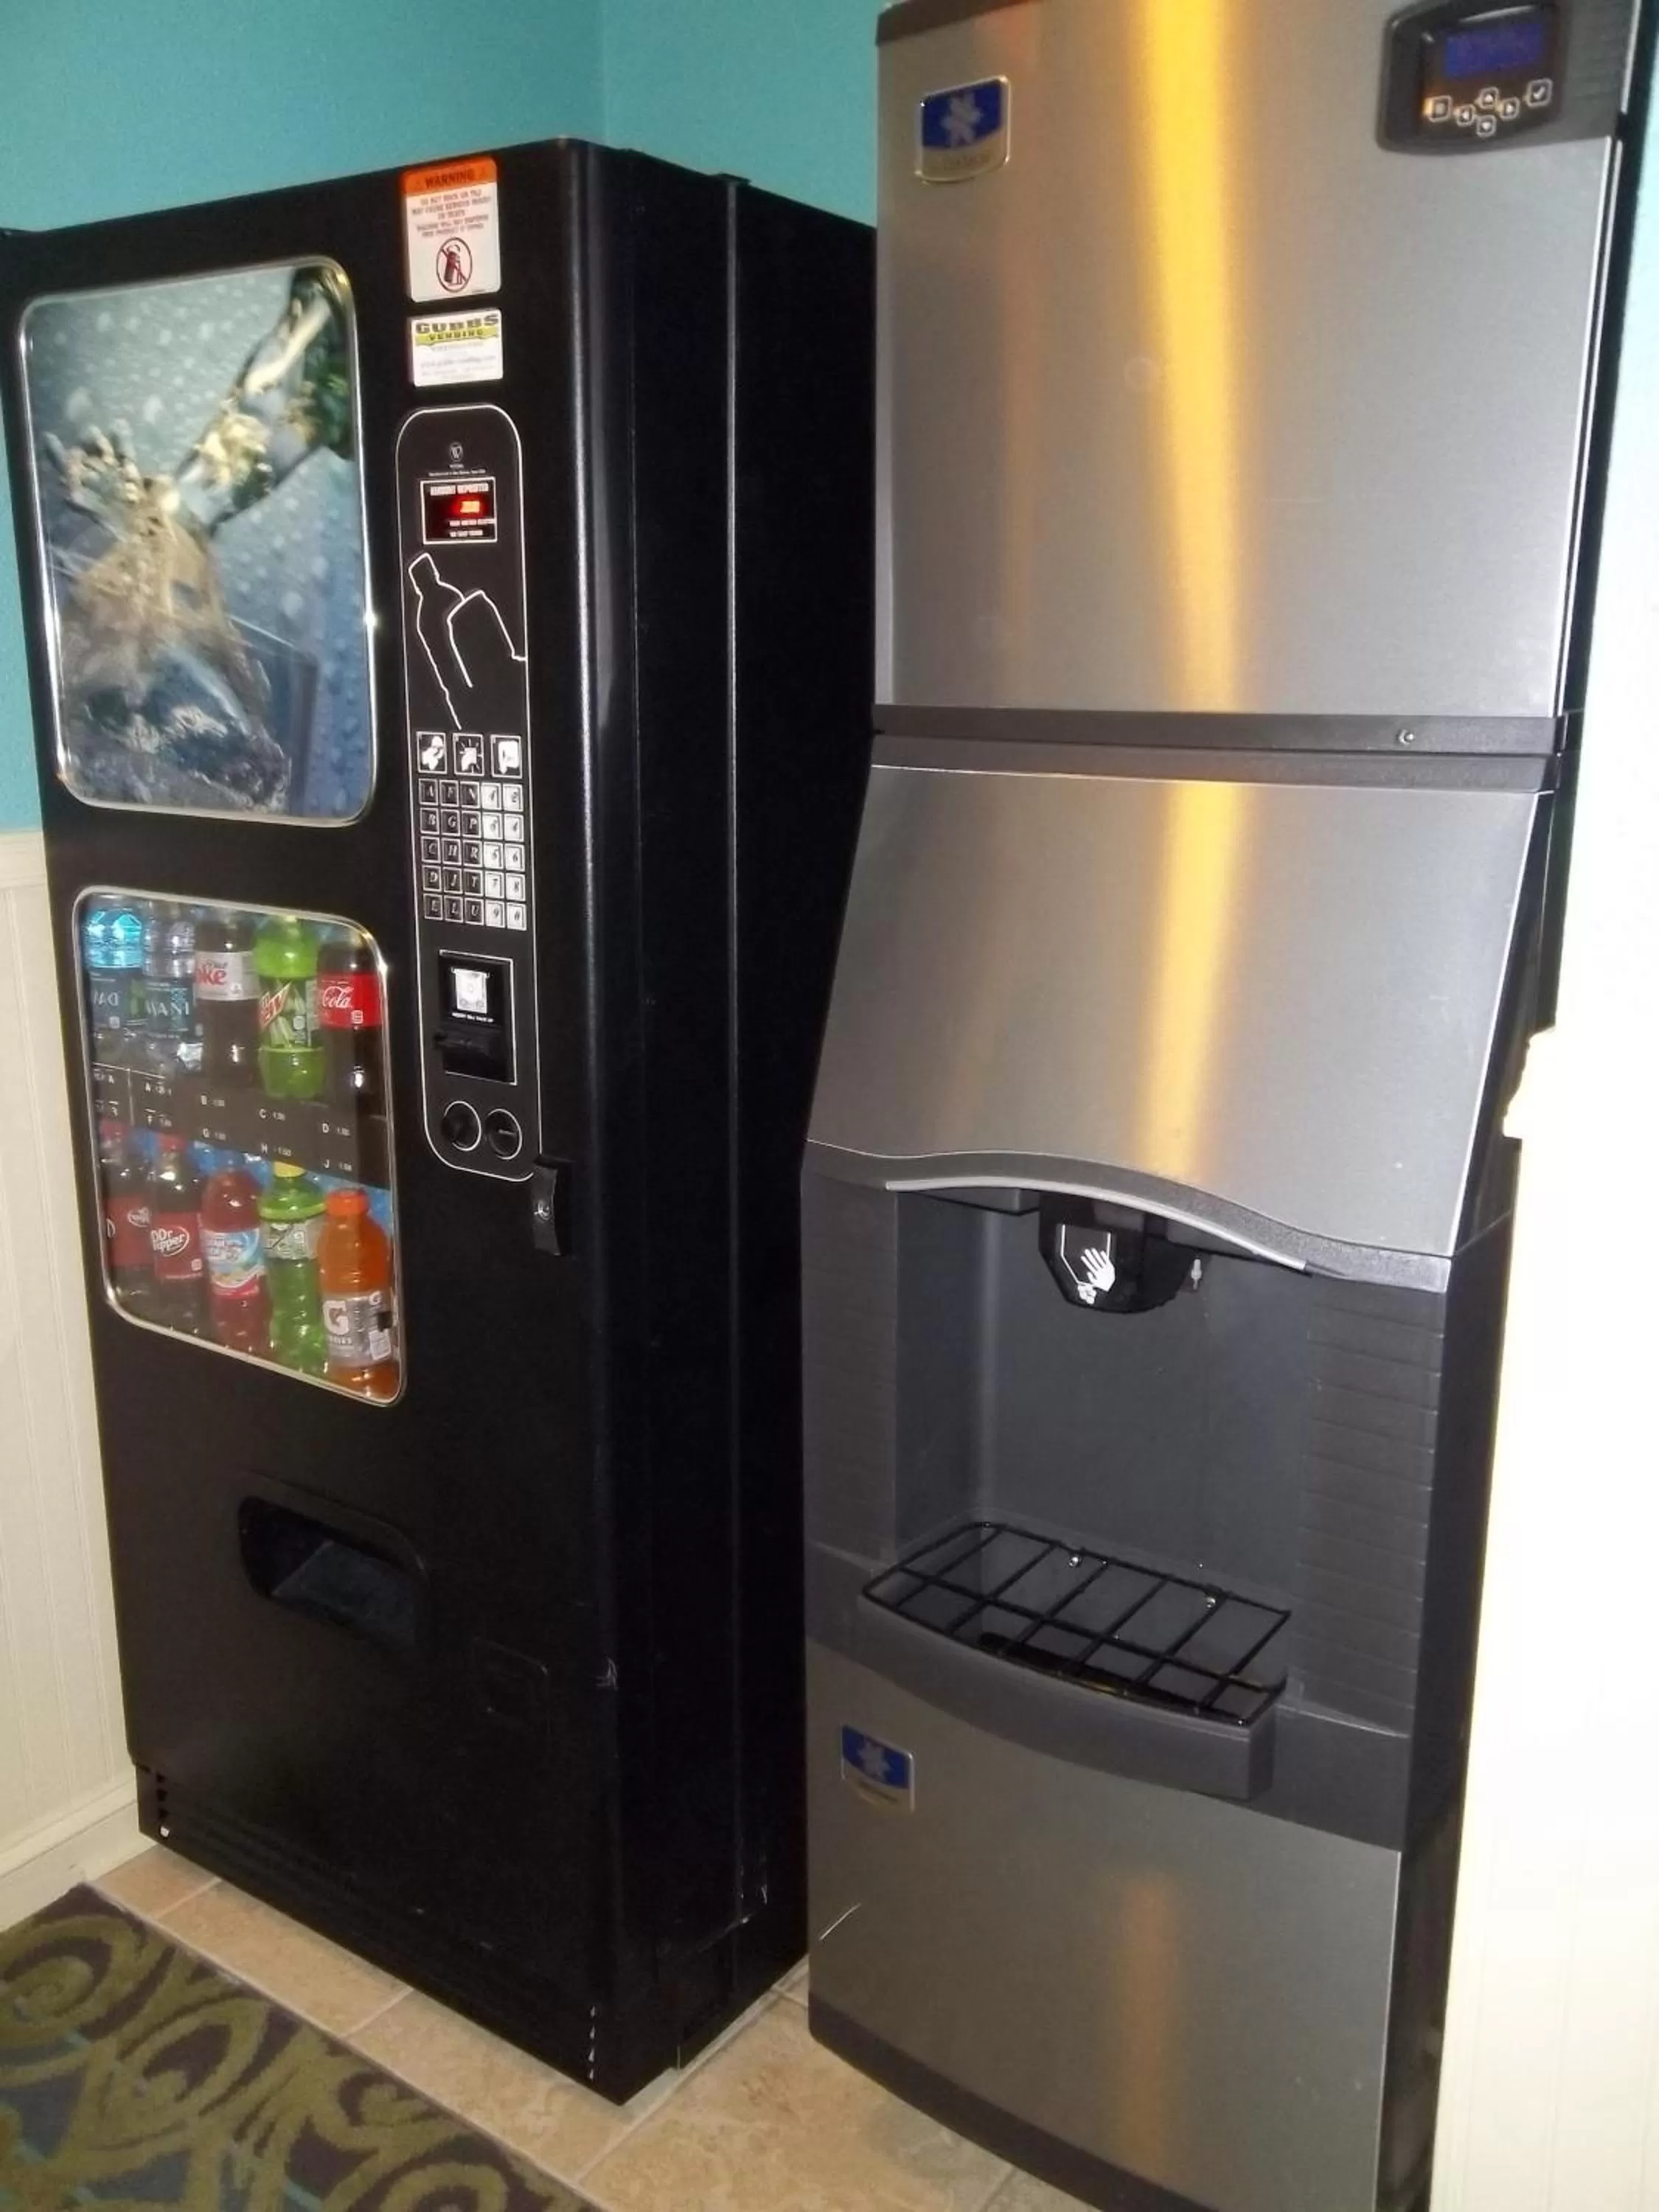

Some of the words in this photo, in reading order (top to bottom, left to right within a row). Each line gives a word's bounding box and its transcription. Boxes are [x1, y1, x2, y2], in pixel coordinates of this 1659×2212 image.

[425, 169, 474, 188] WARNING
[428, 814, 436, 825] B
[448, 816, 456, 827] G
[469, 818, 477, 830] P
[428, 843, 437, 854] C
[448, 845, 457, 856] H
[470, 846, 479, 858] R
[430, 872, 437, 883] D
[322, 986, 355, 1009] Cola
[260, 1108, 266, 1119] C
[202, 1128, 210, 1138] G
[321, 1123, 329, 1133] D
[261, 1144, 268, 1154] H
[323, 1300, 350, 1335] G
